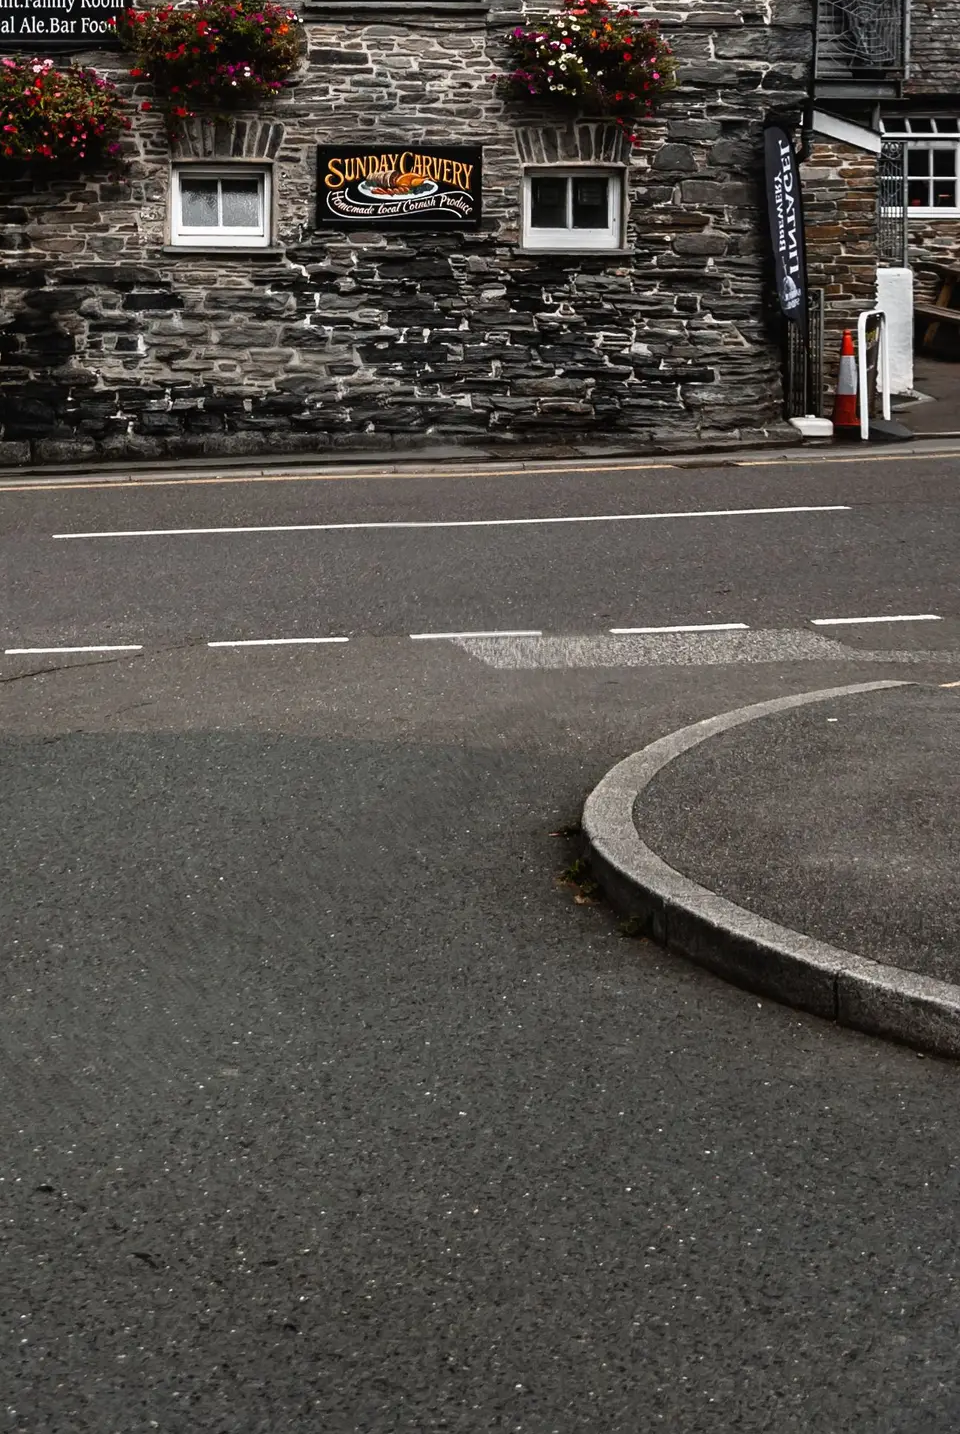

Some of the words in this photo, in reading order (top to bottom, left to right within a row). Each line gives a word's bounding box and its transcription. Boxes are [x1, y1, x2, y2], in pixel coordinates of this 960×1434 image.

[324, 153, 400, 189] SUNDAY
[399, 151, 474, 191] CARVERY
[331, 190, 375, 215] Homemade
[377, 201, 402, 215] Local
[402, 196, 436, 213] Cornish
[440, 194, 473, 215] Produce
